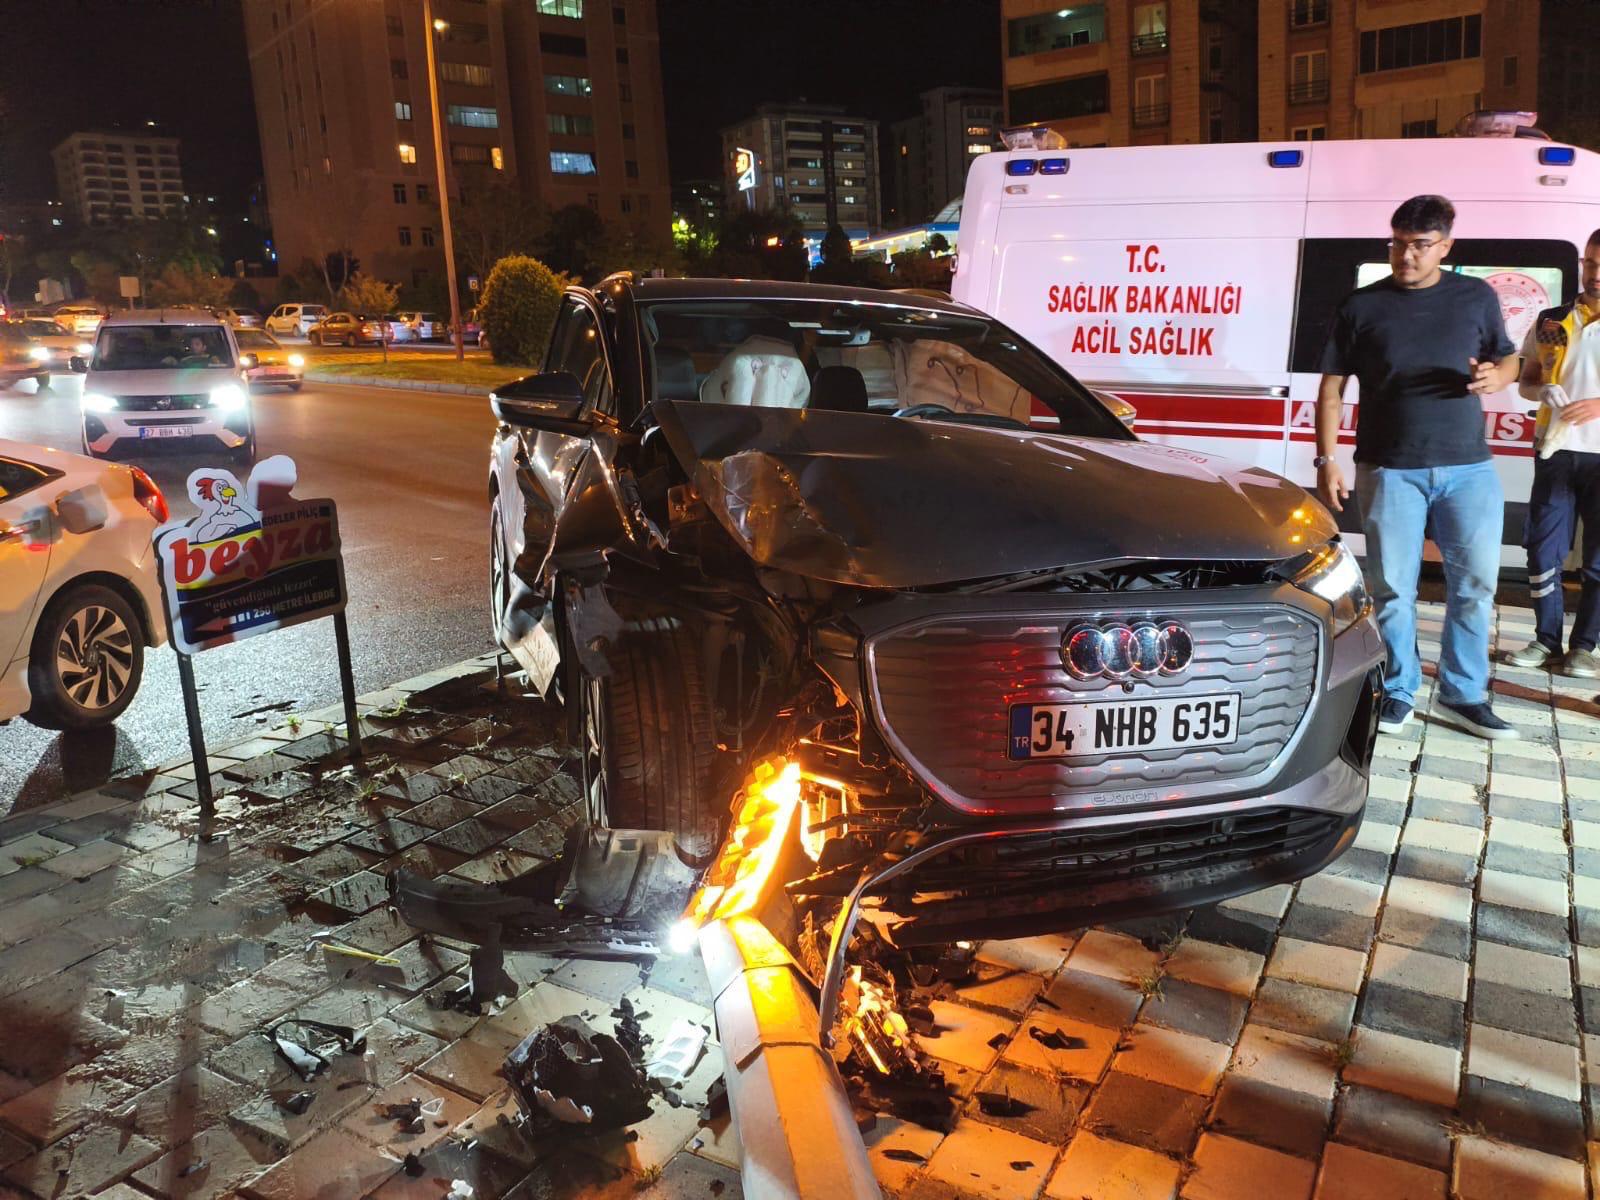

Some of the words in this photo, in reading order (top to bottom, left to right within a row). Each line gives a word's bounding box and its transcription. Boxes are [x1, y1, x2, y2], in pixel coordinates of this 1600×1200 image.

[1126, 245, 1166, 273] T.C.
[1048, 282, 1120, 313] SAĞLIK
[1126, 282, 1242, 315] BAKANLIĞI
[1071, 319, 1121, 354] ACİL
[1129, 320, 1215, 356] SAĞLIK
[169, 520, 335, 584] beyza
[253, 606, 271, 619] 250
[272, 595, 304, 614] METRE
[1014, 736, 1029, 748] TR
[1033, 710, 1074, 752] 34
[1095, 705, 1157, 748] NHB
[1172, 700, 1231, 742] 635
